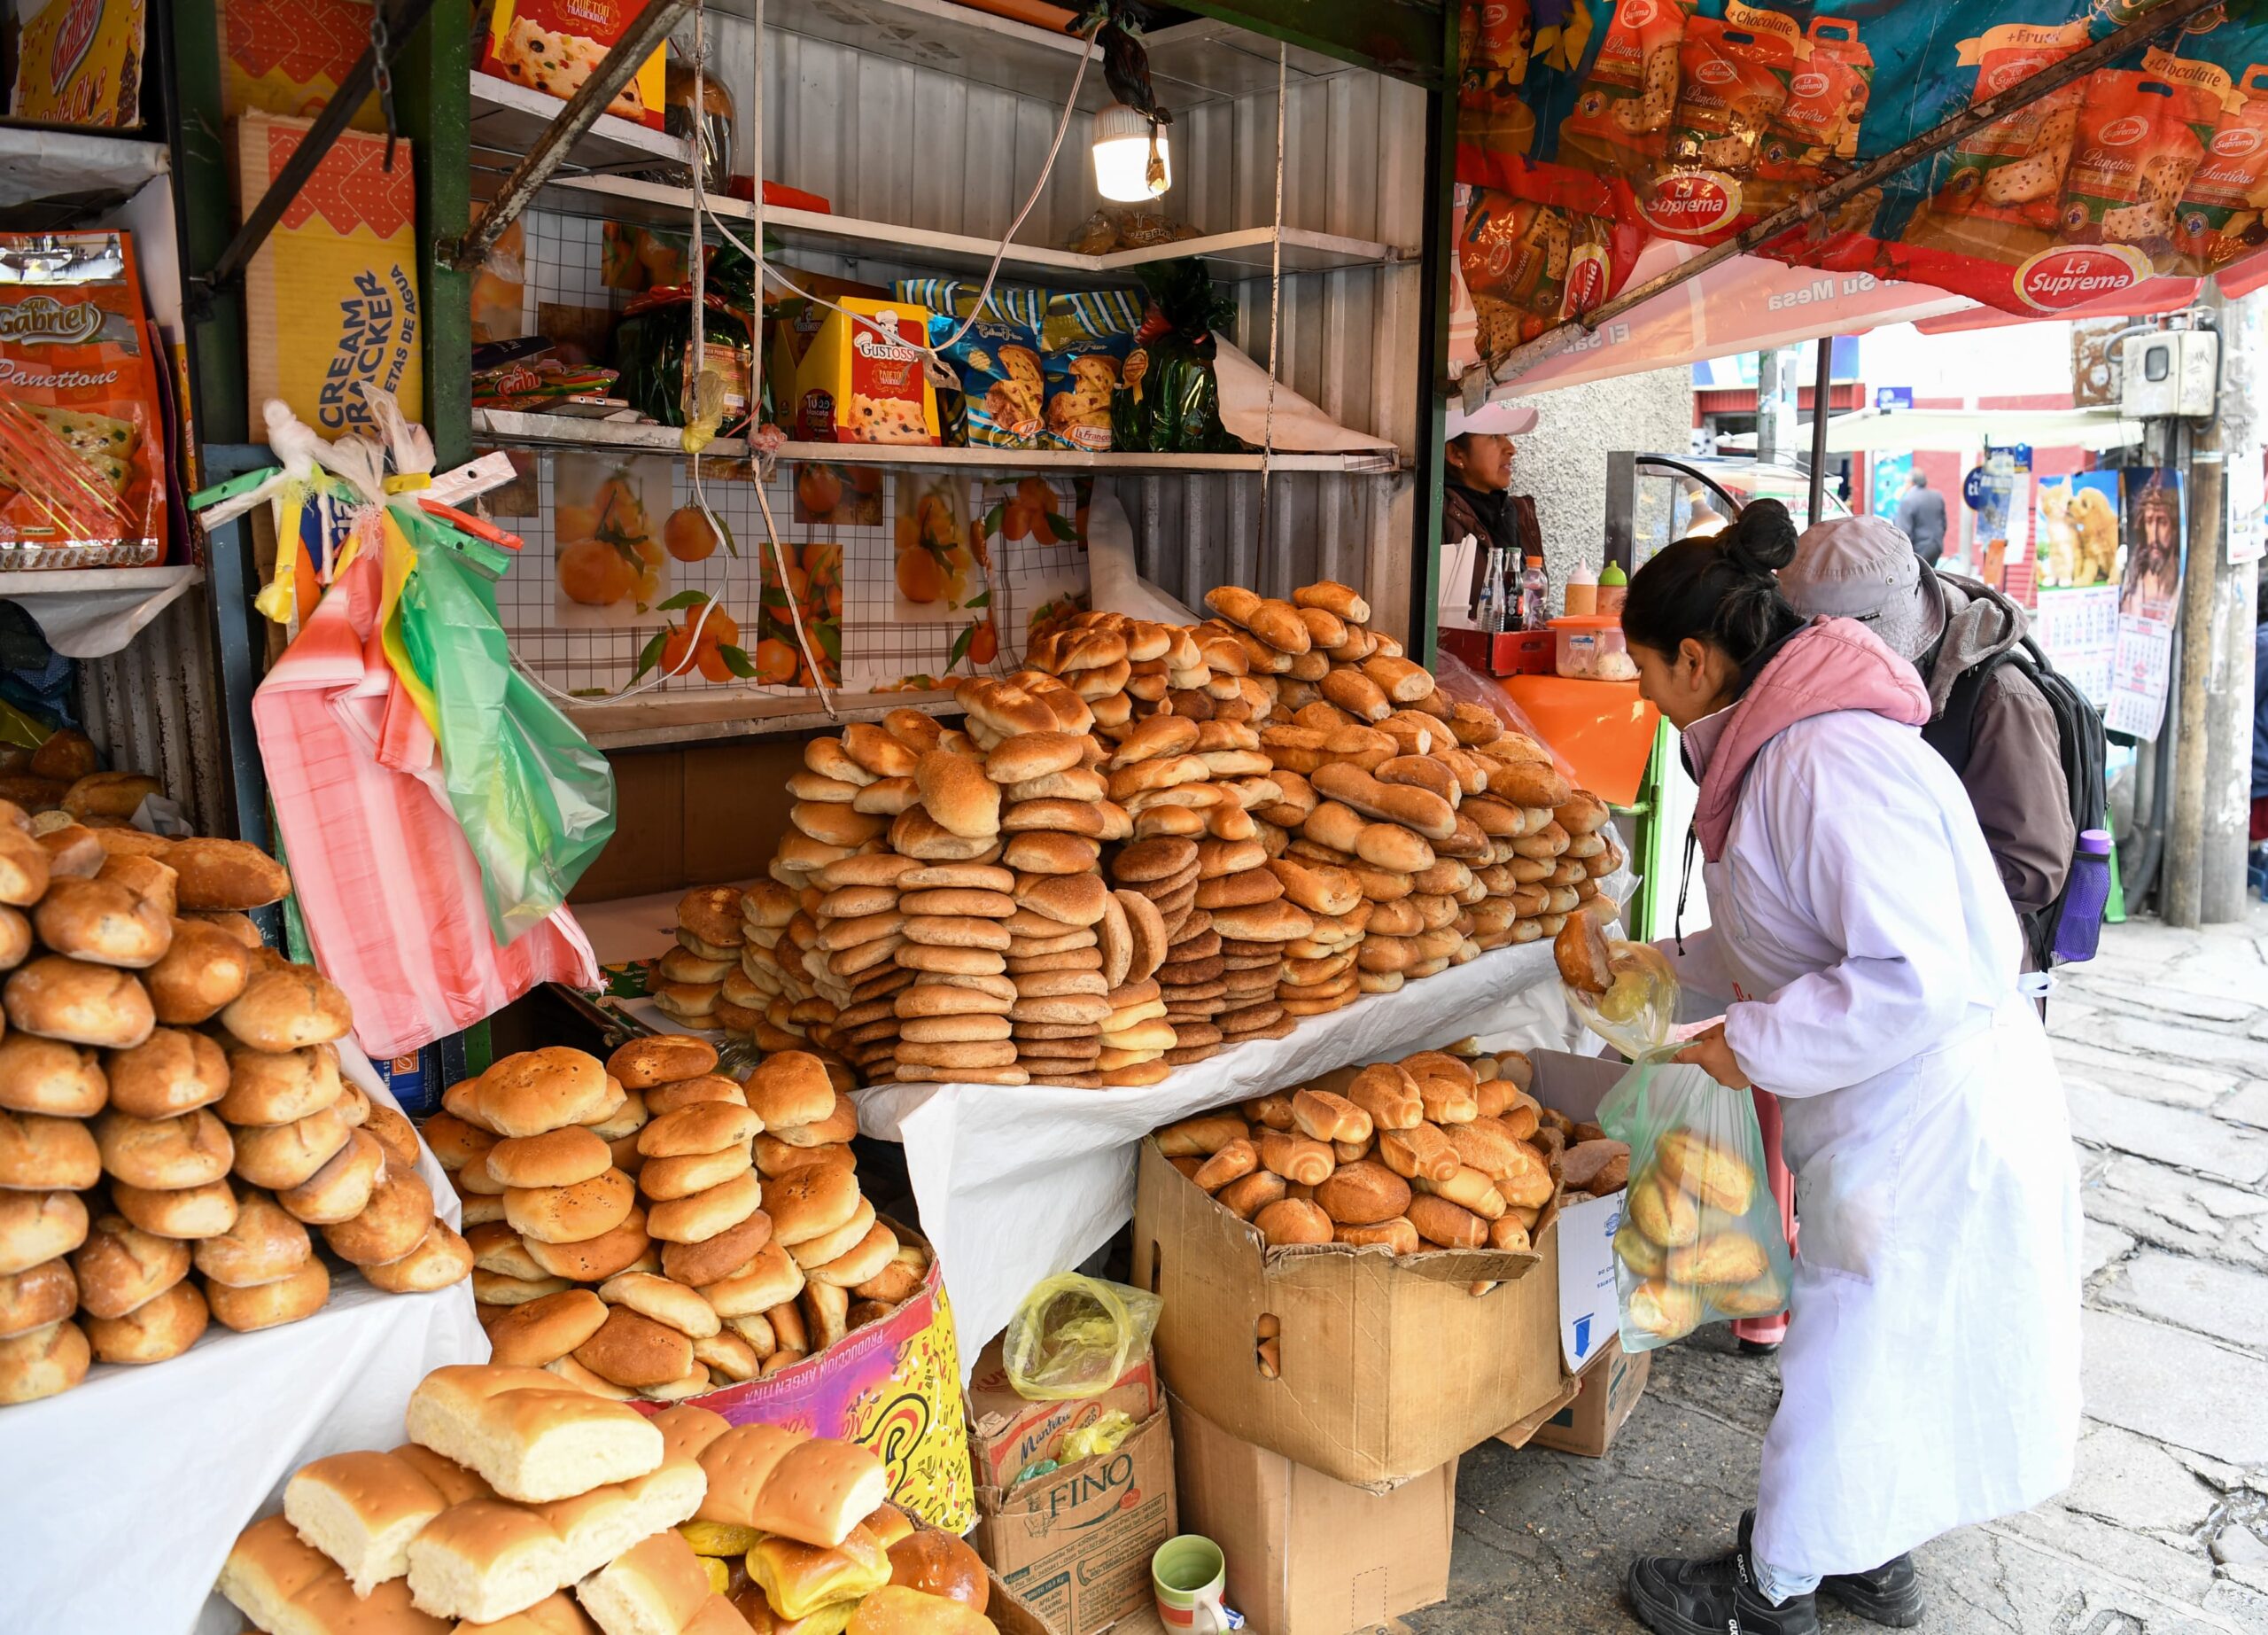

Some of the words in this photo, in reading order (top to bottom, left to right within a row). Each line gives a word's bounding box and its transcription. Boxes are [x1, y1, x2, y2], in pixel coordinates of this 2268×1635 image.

[1625, 9, 1650, 22] Suprema
[1730, 11, 1794, 36] +Chocolate
[2216, 139, 2254, 149] Suprema
[2077, 148, 2136, 172] Panetón
[2195, 162, 2256, 184] Surtidas
[1674, 183, 1694, 199] La
[1646, 196, 1724, 214] Suprema
[2063, 257, 2091, 275] La
[390, 263, 417, 315] AGUA
[2027, 273, 2129, 297] Suprema
[19, 299, 50, 310] san
[0, 302, 88, 335] Gabriel
[400, 317, 416, 344] DE
[345, 269, 392, 434] RACKER
[861, 342, 915, 361] GUSTOSS
[0, 357, 118, 388] Panettone
[319, 299, 366, 430] CREAM
[384, 346, 408, 393] ETAS
[1076, 427, 1083, 437] La
[820, 1329, 884, 1374] PRODUCCION
[744, 1368, 818, 1405] ARGENTINA
[1049, 1453, 1134, 1519] FINO
[1037, 1589, 1062, 1607] APILADO
